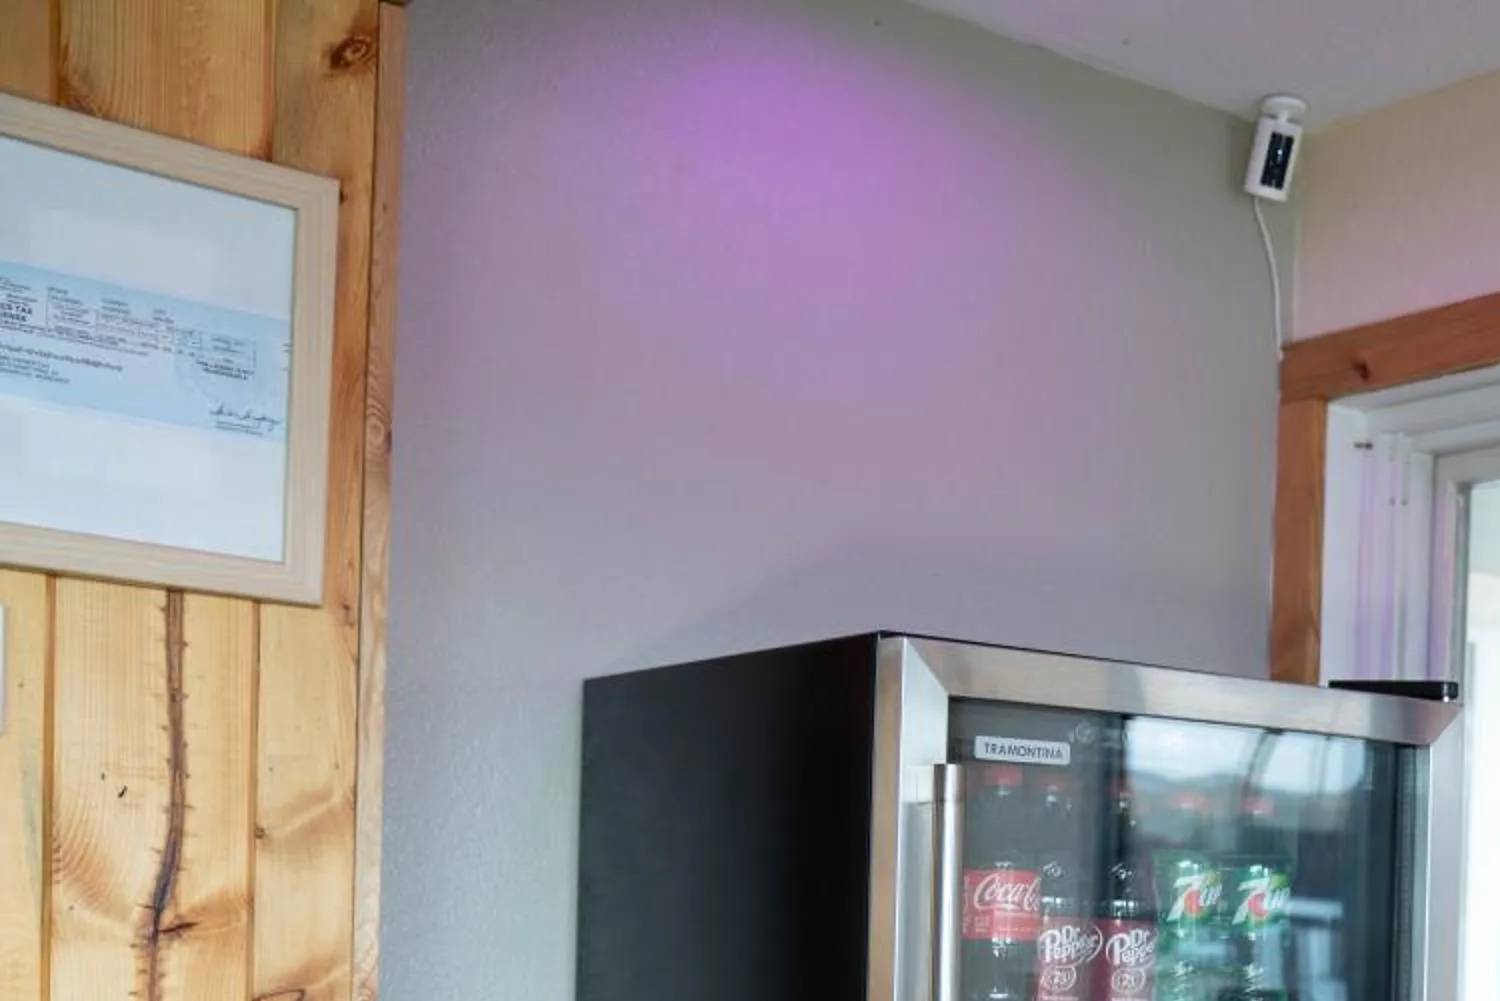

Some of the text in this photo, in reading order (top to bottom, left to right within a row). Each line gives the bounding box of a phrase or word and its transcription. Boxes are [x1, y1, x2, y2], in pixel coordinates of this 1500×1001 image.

[984, 740, 1063, 760] TRAMONTINA
[1061, 925, 1081, 943] Dr
[1130, 929, 1150, 946] Dr
[1106, 932, 1157, 966] Peppe
